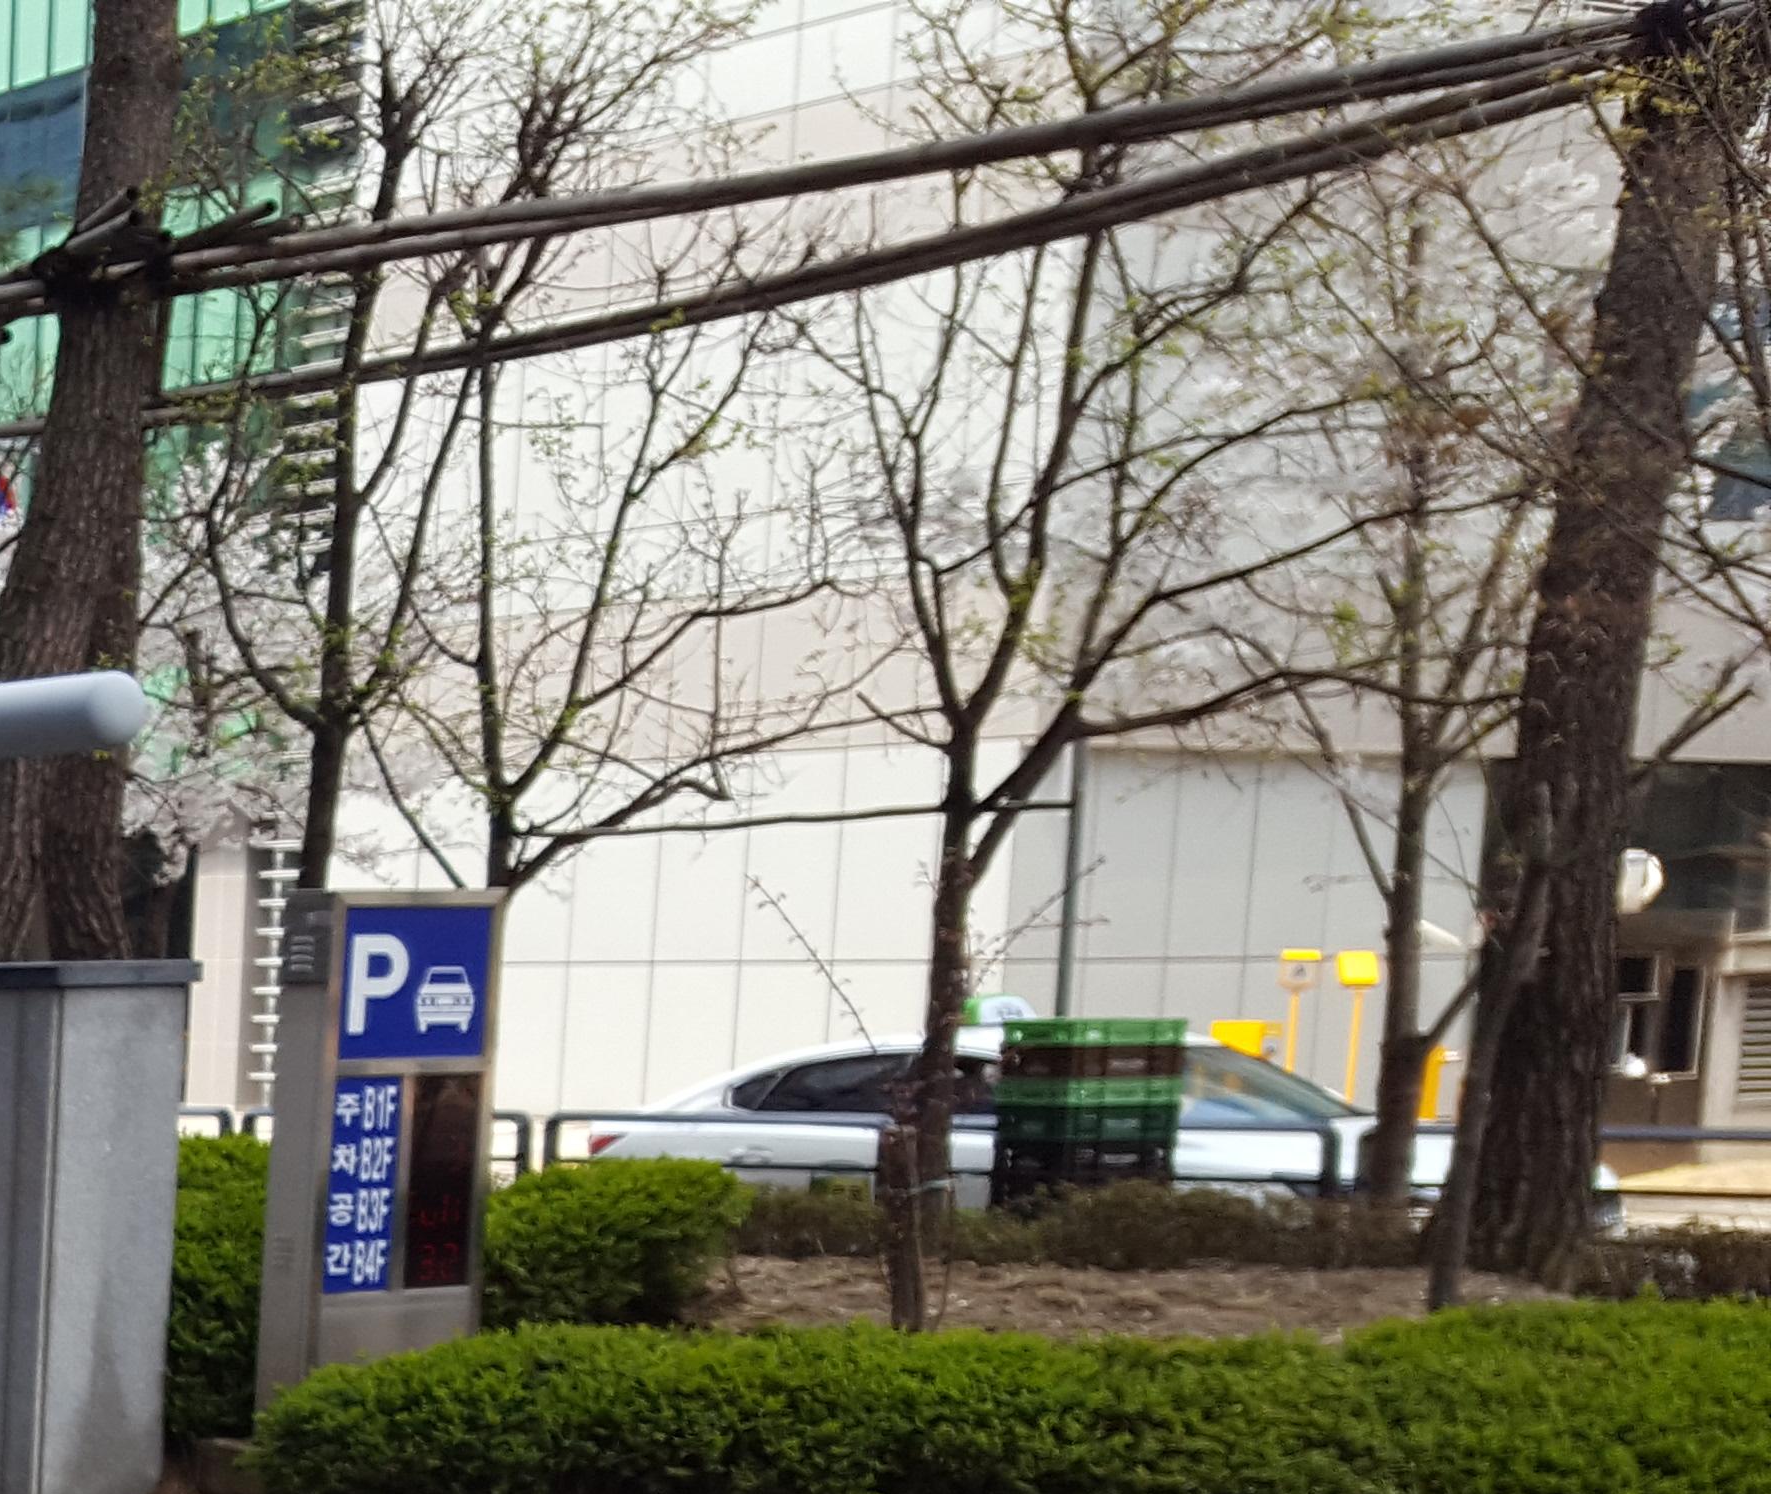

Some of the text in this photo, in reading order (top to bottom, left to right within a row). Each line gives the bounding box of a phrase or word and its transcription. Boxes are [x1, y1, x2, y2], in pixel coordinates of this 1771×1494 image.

[345, 933, 410, 1036] P
[363, 1085, 398, 1131] B1F
[359, 1136, 395, 1183] B2F
[355, 1187, 391, 1234] B3F
[352, 1238, 388, 1286] B4F
